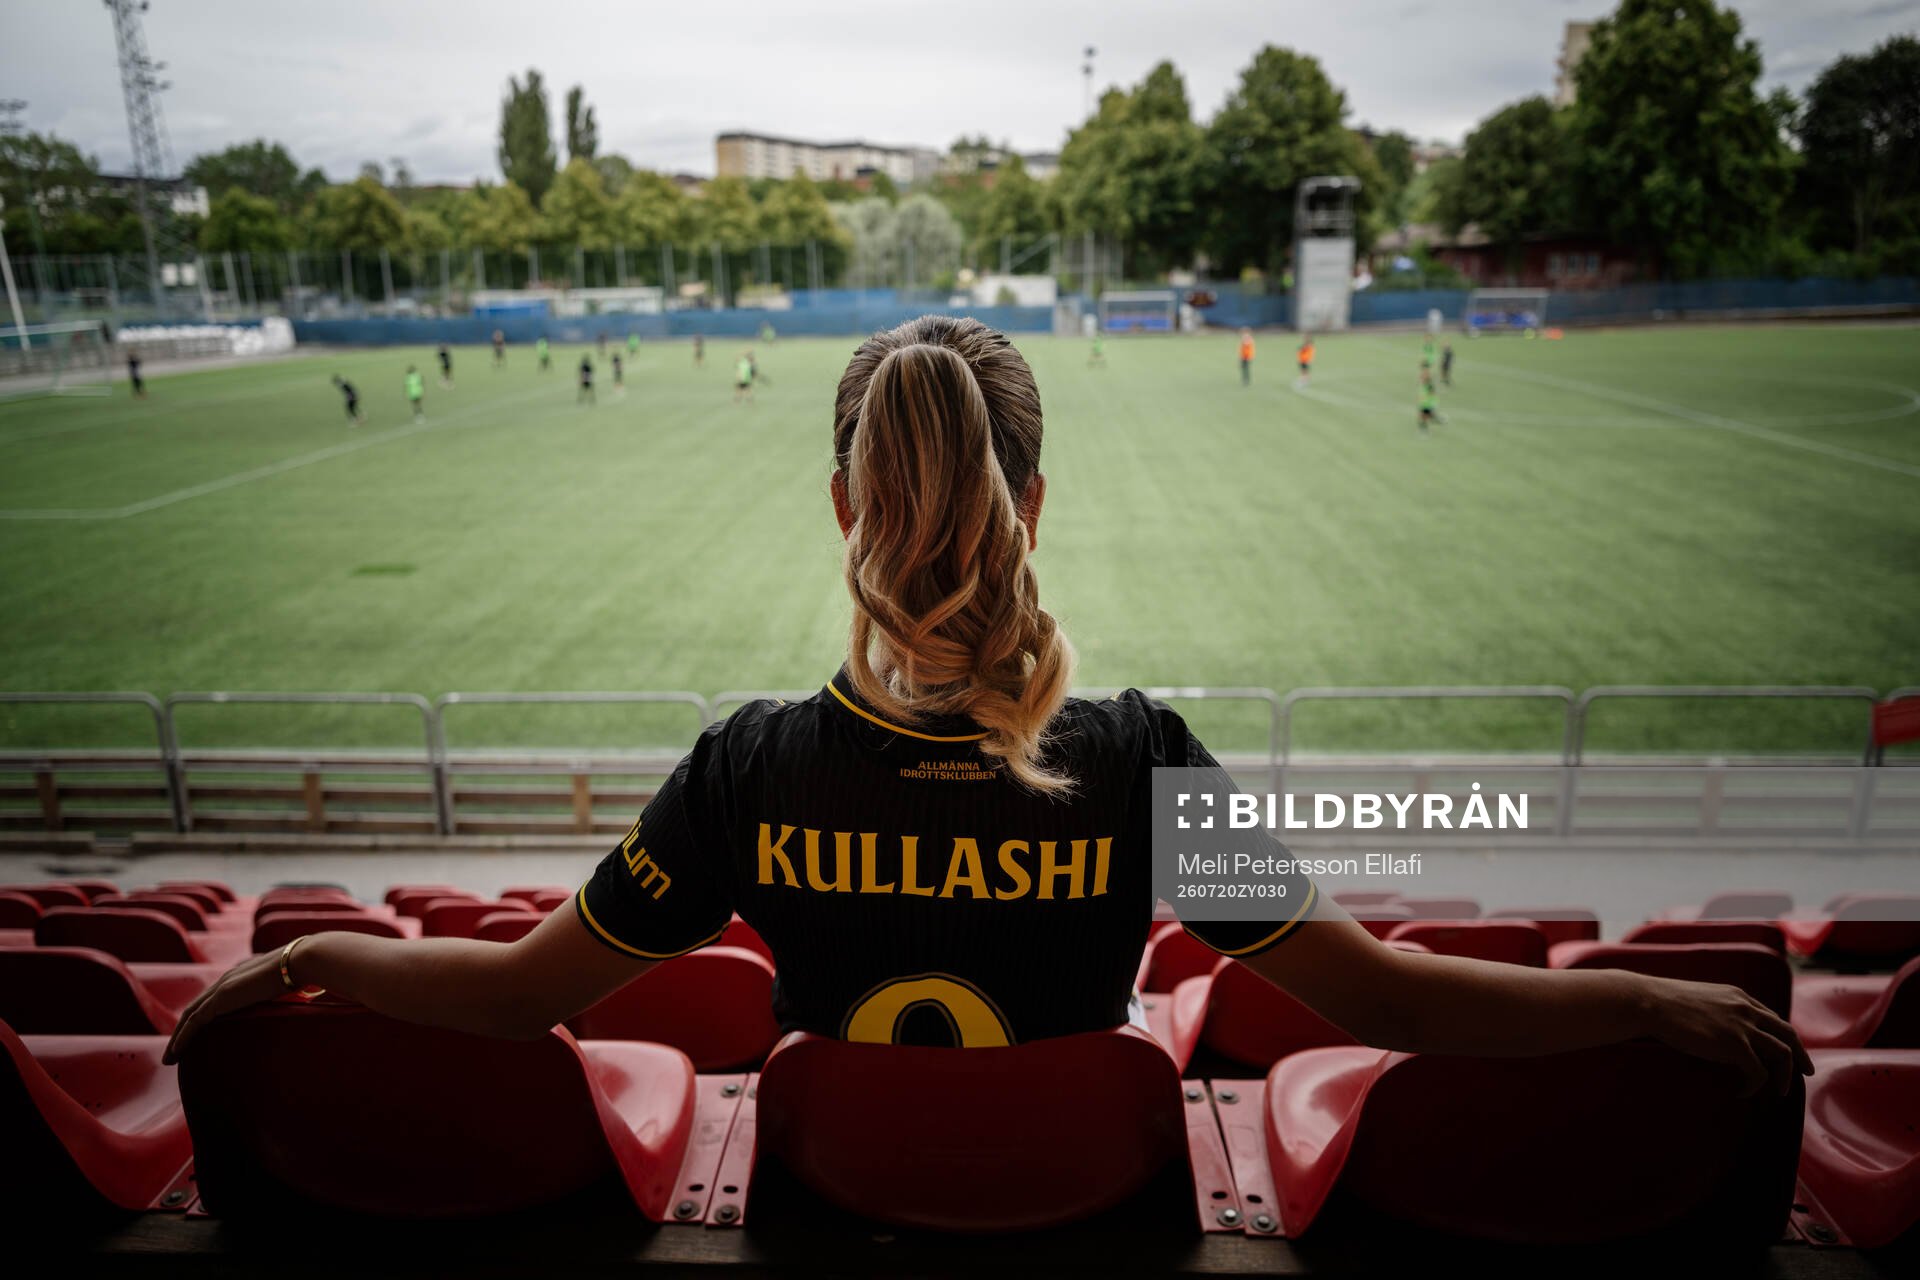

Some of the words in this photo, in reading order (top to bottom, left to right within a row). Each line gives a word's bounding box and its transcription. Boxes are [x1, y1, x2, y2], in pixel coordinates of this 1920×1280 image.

[900, 768, 997, 780] IDROTTSKLUBBEN
[918, 760, 980, 771] ALLMÄNNA
[622, 820, 671, 900] ium
[757, 822, 1114, 900] KULLASHI
